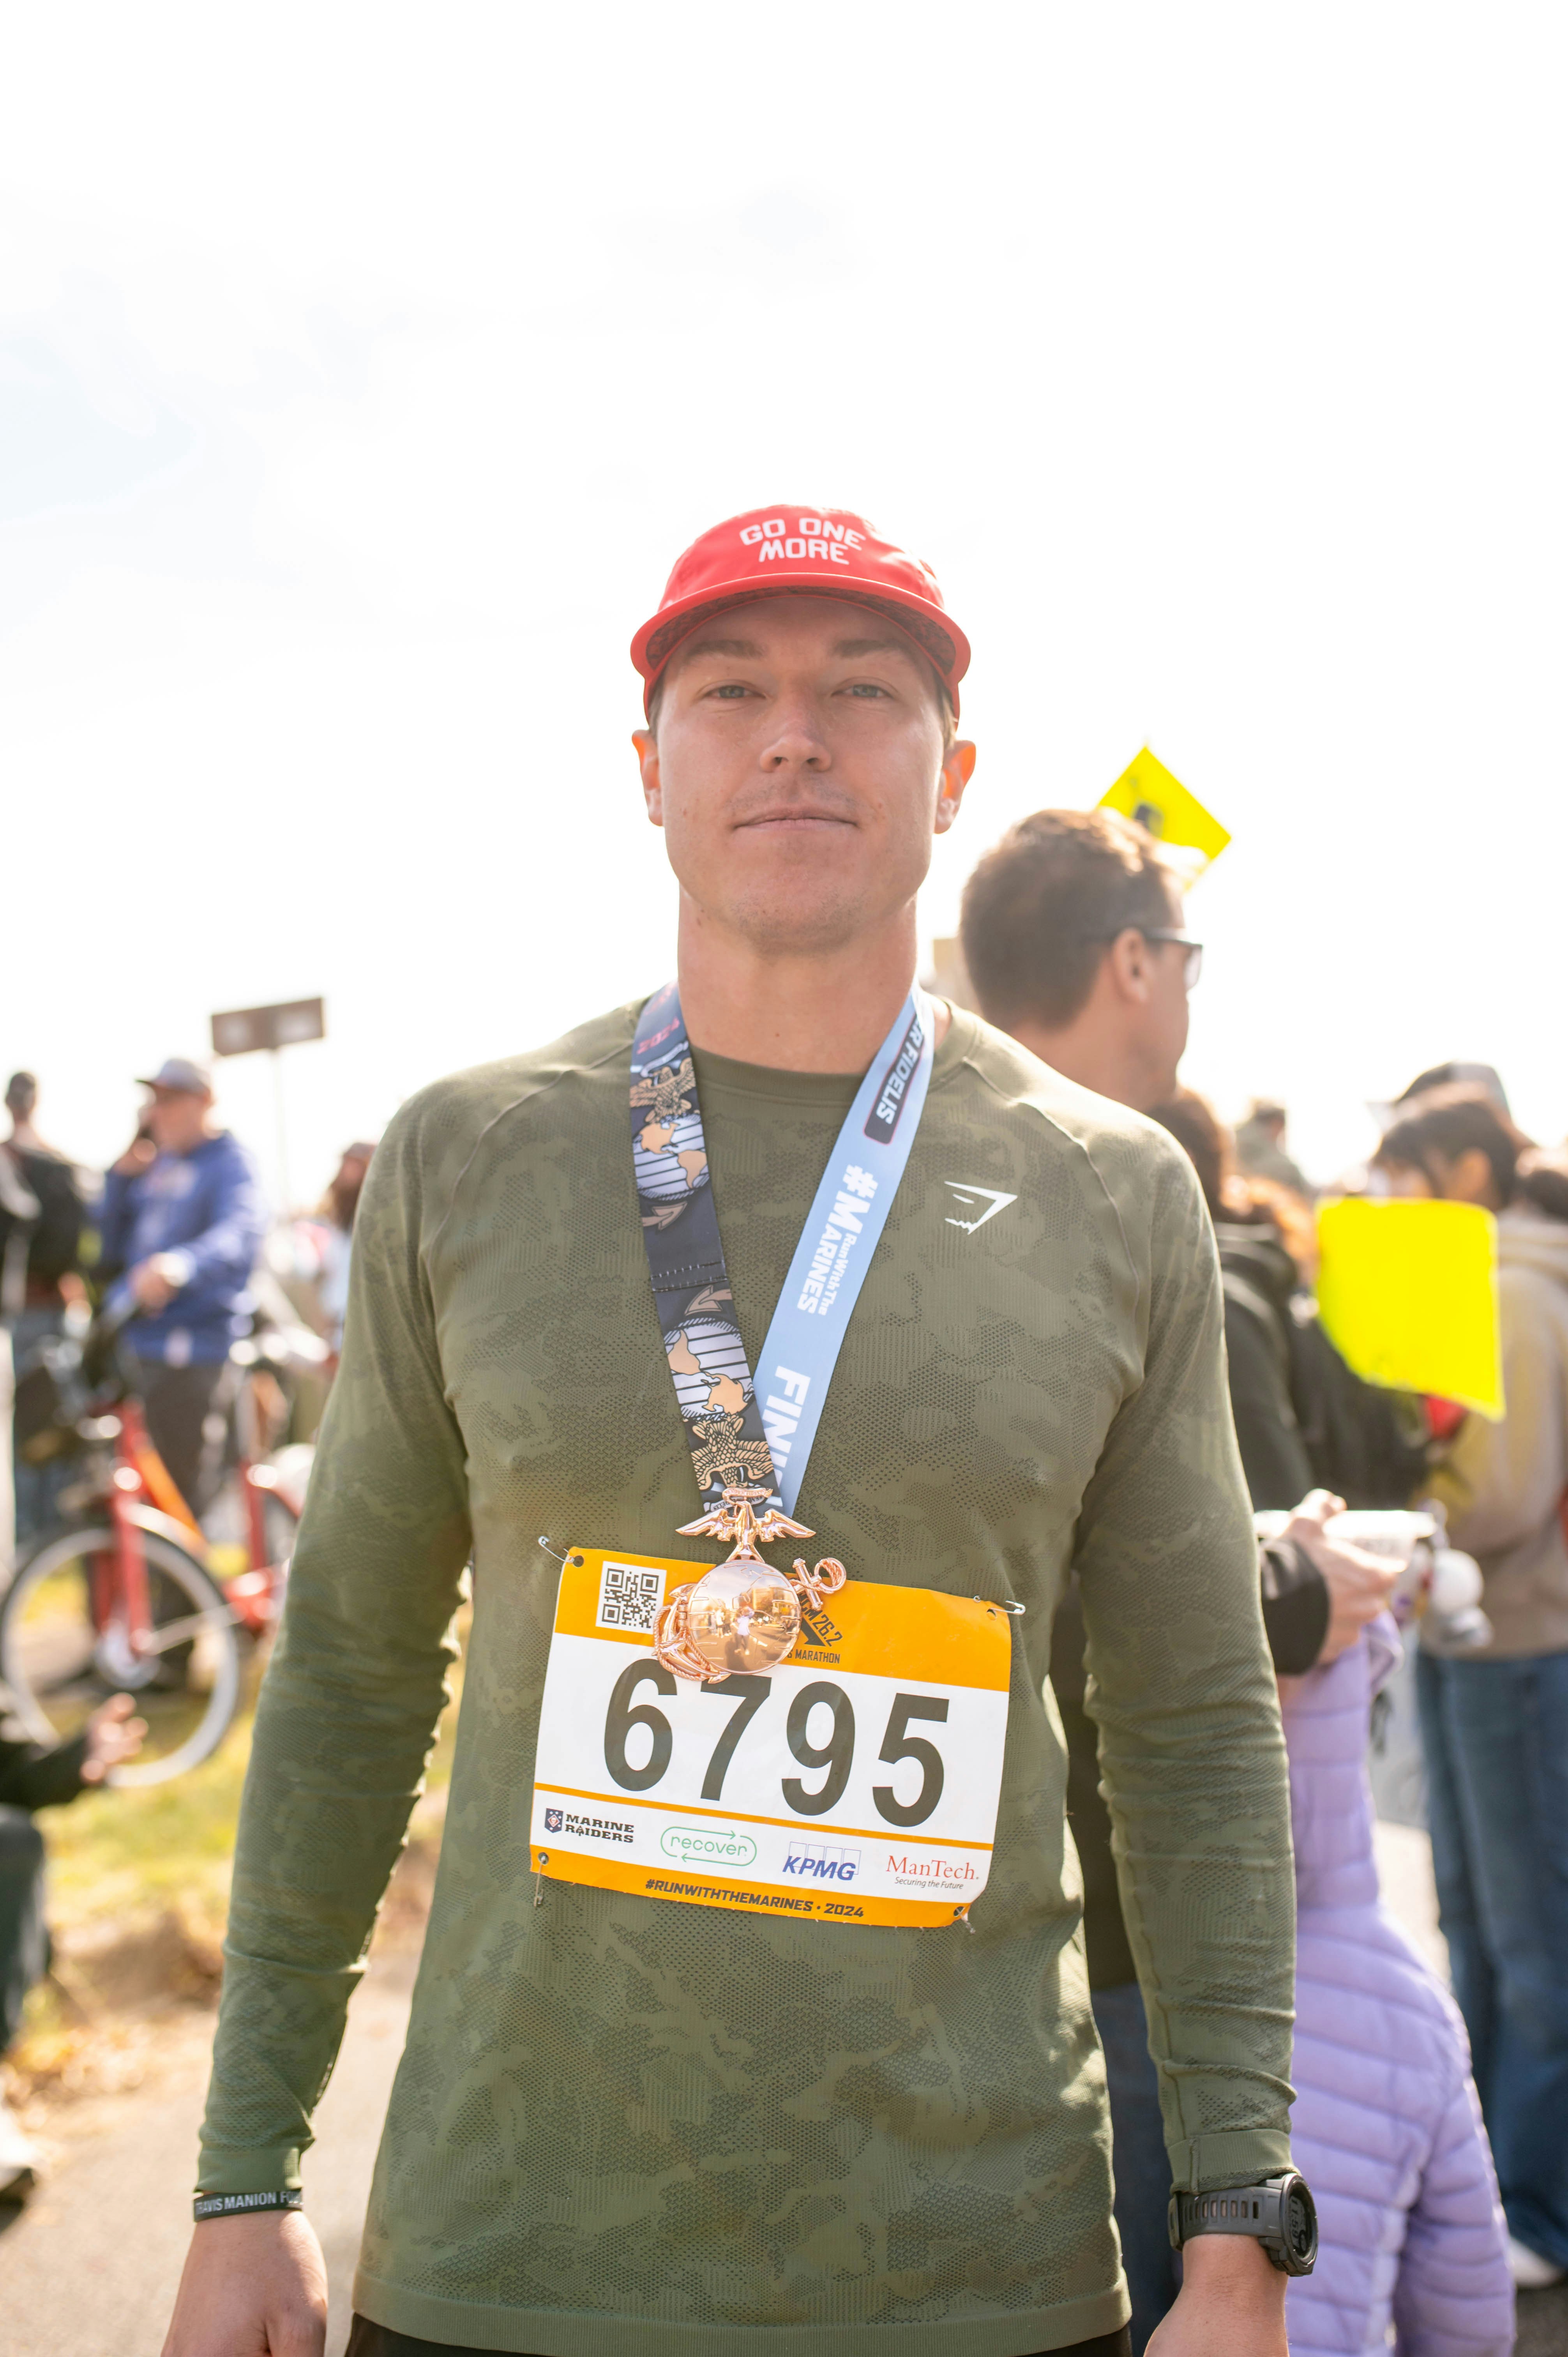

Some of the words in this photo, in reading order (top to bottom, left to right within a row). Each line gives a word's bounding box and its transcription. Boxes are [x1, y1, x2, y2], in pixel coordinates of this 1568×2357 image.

[739, 518, 786, 546] GO
[799, 518, 866, 551] ONE
[759, 537, 850, 565] MORE
[876, 1042, 918, 1125] FIDELIS
[762, 1365, 811, 1488] FINI
[795, 1649, 841, 1664] MARATHON
[604, 1658, 950, 1828] 6795
[565, 1814, 634, 1833] MARINE
[565, 1824, 634, 1843] RAIDERS
[670, 1835, 747, 1856] recover
[782, 1855, 856, 1881] KPMG
[894, 1876, 927, 1888] Securing
[927, 1880, 940, 1888] the
[940, 1881, 964, 1889] Future
[645, 1879, 814, 1912] #RUNWITHTHEMARINES
[824, 1903, 864, 1917] 2024
[224, 2191, 277, 2210] MANION
